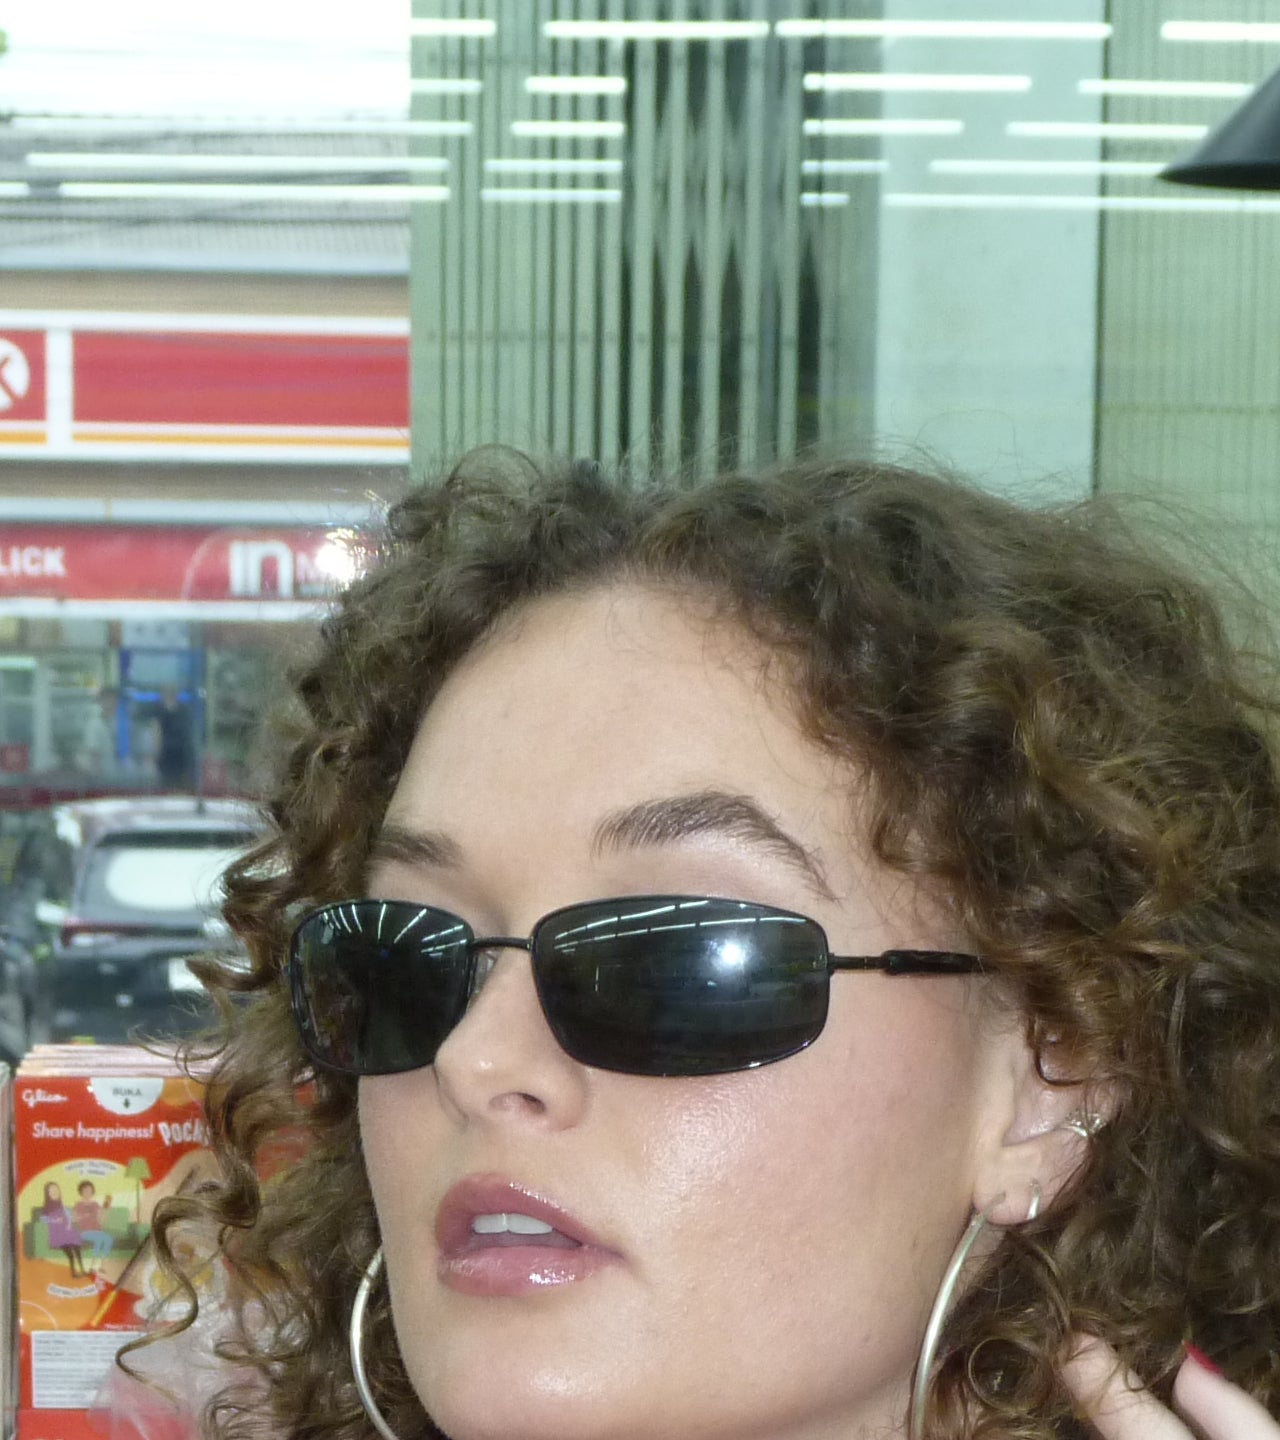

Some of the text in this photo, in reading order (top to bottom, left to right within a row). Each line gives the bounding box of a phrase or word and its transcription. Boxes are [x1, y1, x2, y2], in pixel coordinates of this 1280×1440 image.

[22, 1088, 68, 1108] Glico
[32, 1122, 154, 1140] Share happiness!
